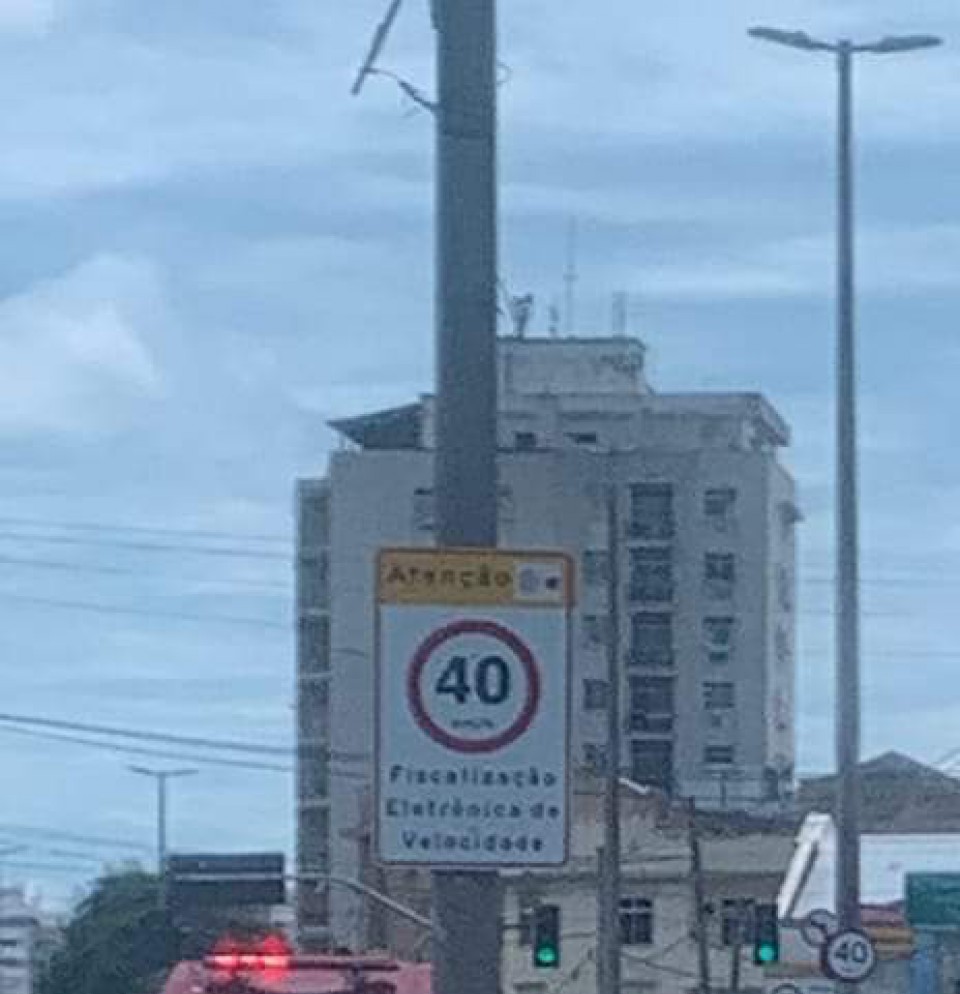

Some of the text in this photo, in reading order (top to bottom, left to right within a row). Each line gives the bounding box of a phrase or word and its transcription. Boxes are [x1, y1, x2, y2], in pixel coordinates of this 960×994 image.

[386, 561, 512, 588] Atenção
[436, 655, 509, 705] 40
[388, 764, 558, 788] Fiscalização
[529, 802, 561, 819] de
[402, 830, 544, 851] Velocidade
[834, 941, 867, 963] 40
